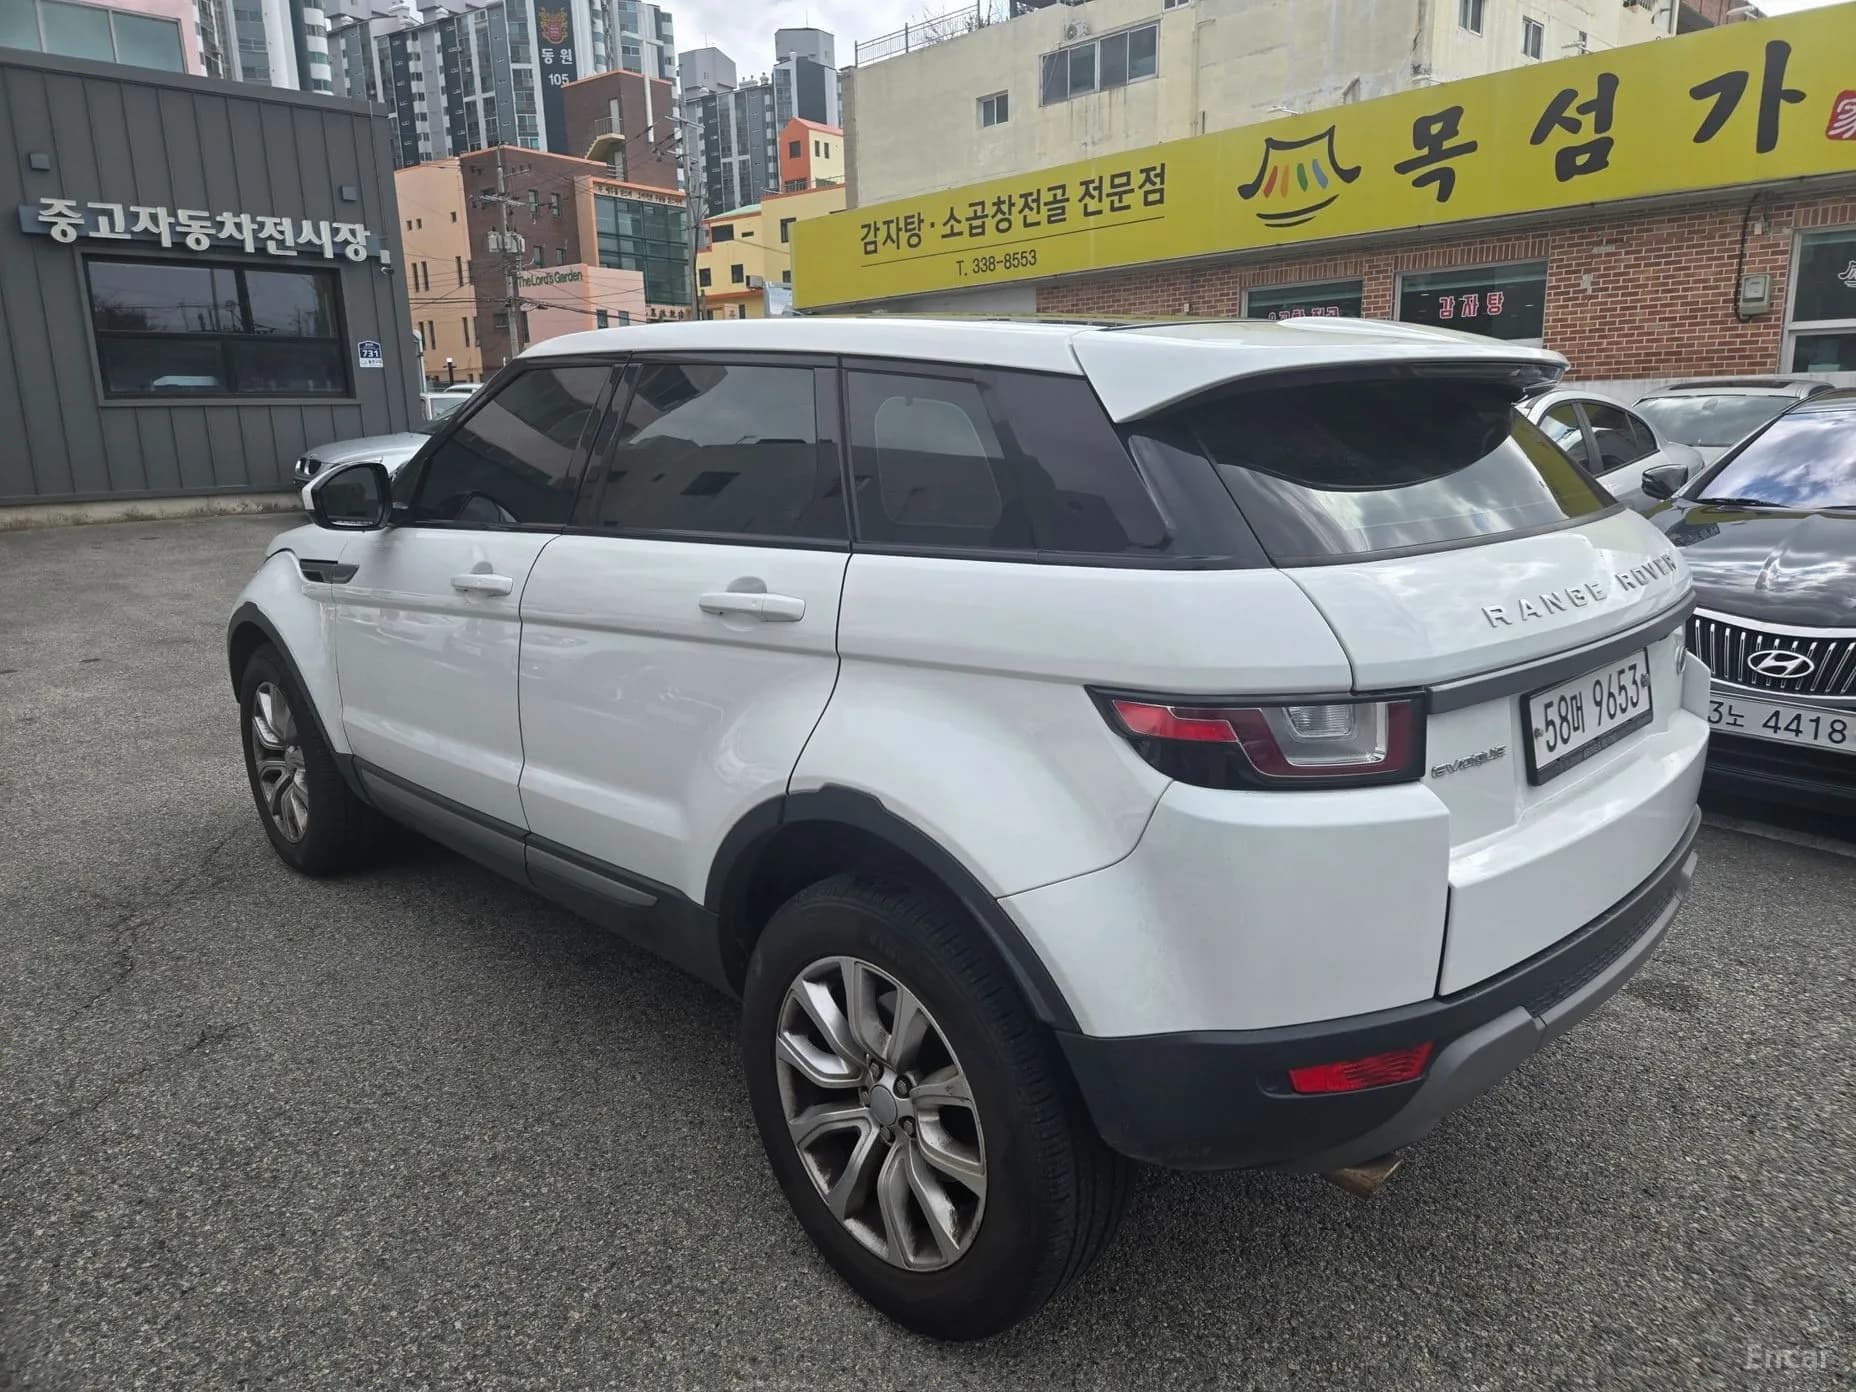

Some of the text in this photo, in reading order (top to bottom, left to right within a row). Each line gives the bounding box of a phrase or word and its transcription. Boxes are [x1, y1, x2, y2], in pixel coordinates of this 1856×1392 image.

[541, 48, 573, 65] 동원
[548, 73, 569, 86] 105
[1078, 162, 1167, 218] 전문점
[38, 197, 371, 262] 중고자동차전시장
[956, 249, 1037, 277] T. 338-8553
[362, 350, 379, 358] 731
[1481, 554, 1678, 628] RANGE ROVER
[1544, 691, 1585, 753] 58머
[1593, 663, 1640, 727] 9653
[1762, 710, 1847, 744] 4418
[1431, 744, 1506, 779] EVOQUE
